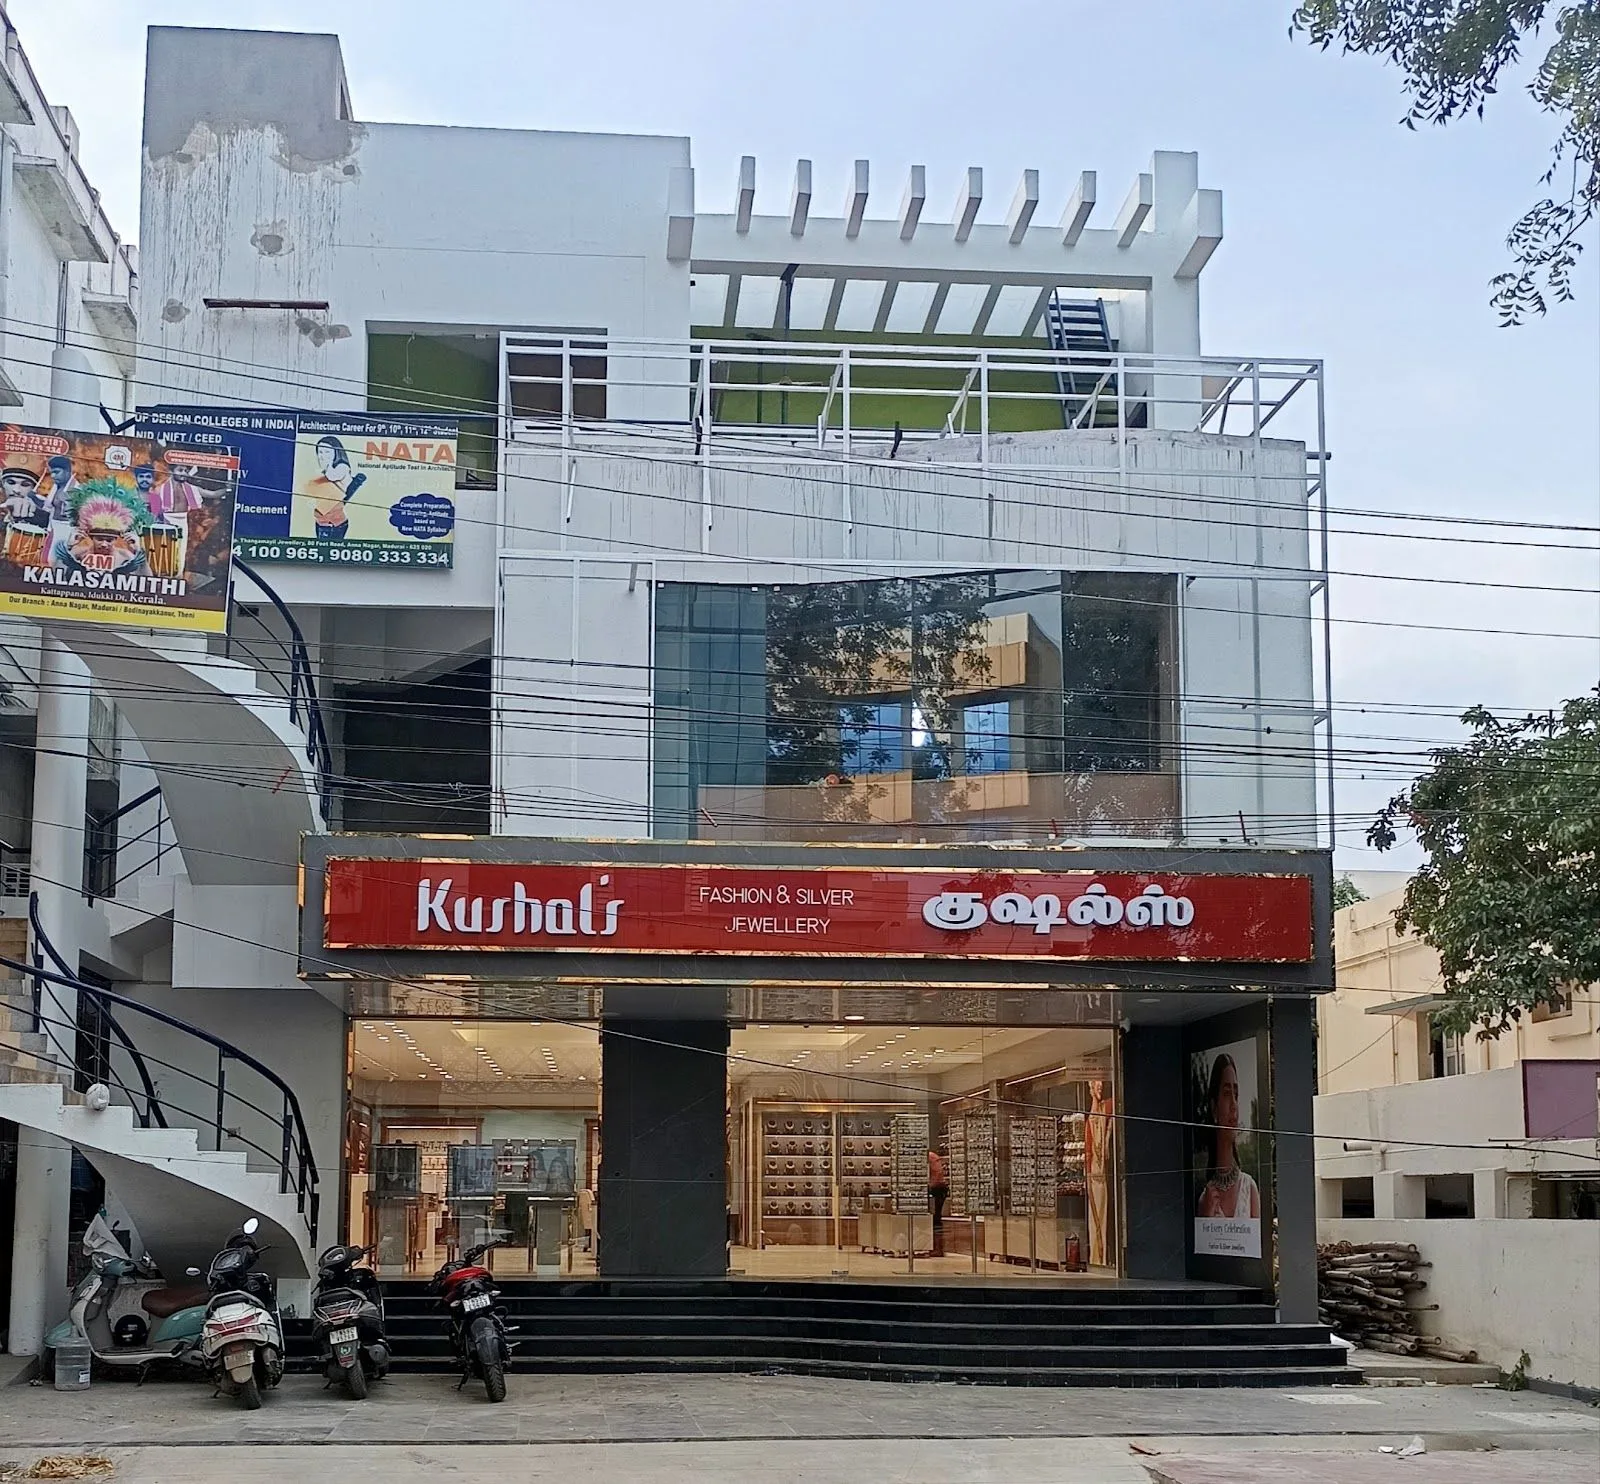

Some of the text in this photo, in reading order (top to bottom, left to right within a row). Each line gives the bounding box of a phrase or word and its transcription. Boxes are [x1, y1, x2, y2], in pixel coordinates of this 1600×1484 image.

[152, 413, 192, 424] DESIGN
[194, 414, 249, 428] COLLEGES
[251, 418, 263, 428] IN
[265, 418, 295, 430] INDIA
[299, 420, 341, 431] Architecture
[342, 422, 364, 432] Career
[365, 423, 377, 433] For
[4, 433, 15, 442] 73
[16, 434, 28, 443] 73
[30, 436, 41, 445] 73
[162, 432, 186, 442] NIFT
[194, 433, 222, 444] CEED
[366, 441, 456, 464] NATA
[382, 464, 406, 472] Aptitude
[235, 503, 288, 515] Placement
[424, 502, 451, 510] Preparation
[426, 526, 447, 534] Syllabus
[240, 538, 277, 546] Thangamayil
[362, 542, 381, 550] Nagar,
[82, 554, 114, 570] 4M
[248, 546, 280, 558] 100
[286, 547, 324, 562] 965,
[330, 548, 374, 562] 9080
[379, 551, 412, 564] 333
[416, 552, 450, 565] 334
[23, 566, 186, 596] KALASAMITHI
[40, 586, 86, 598] Kattappana,
[88, 591, 114, 600] Idukki
[130, 592, 166, 605] Kerala.
[22, 598, 45, 606] Branch
[50, 600, 68, 608] Anna
[69, 602, 90, 610] Nagar,
[92, 603, 119, 612] Madurai
[178, 610, 195, 618] Theni
[700, 884, 854, 906] FASHION & SILVER
[418, 874, 625, 934] Kushal's
[922, 884, 1194, 934] குஷல்ஸ்
[725, 916, 830, 934] JEWELLERY
